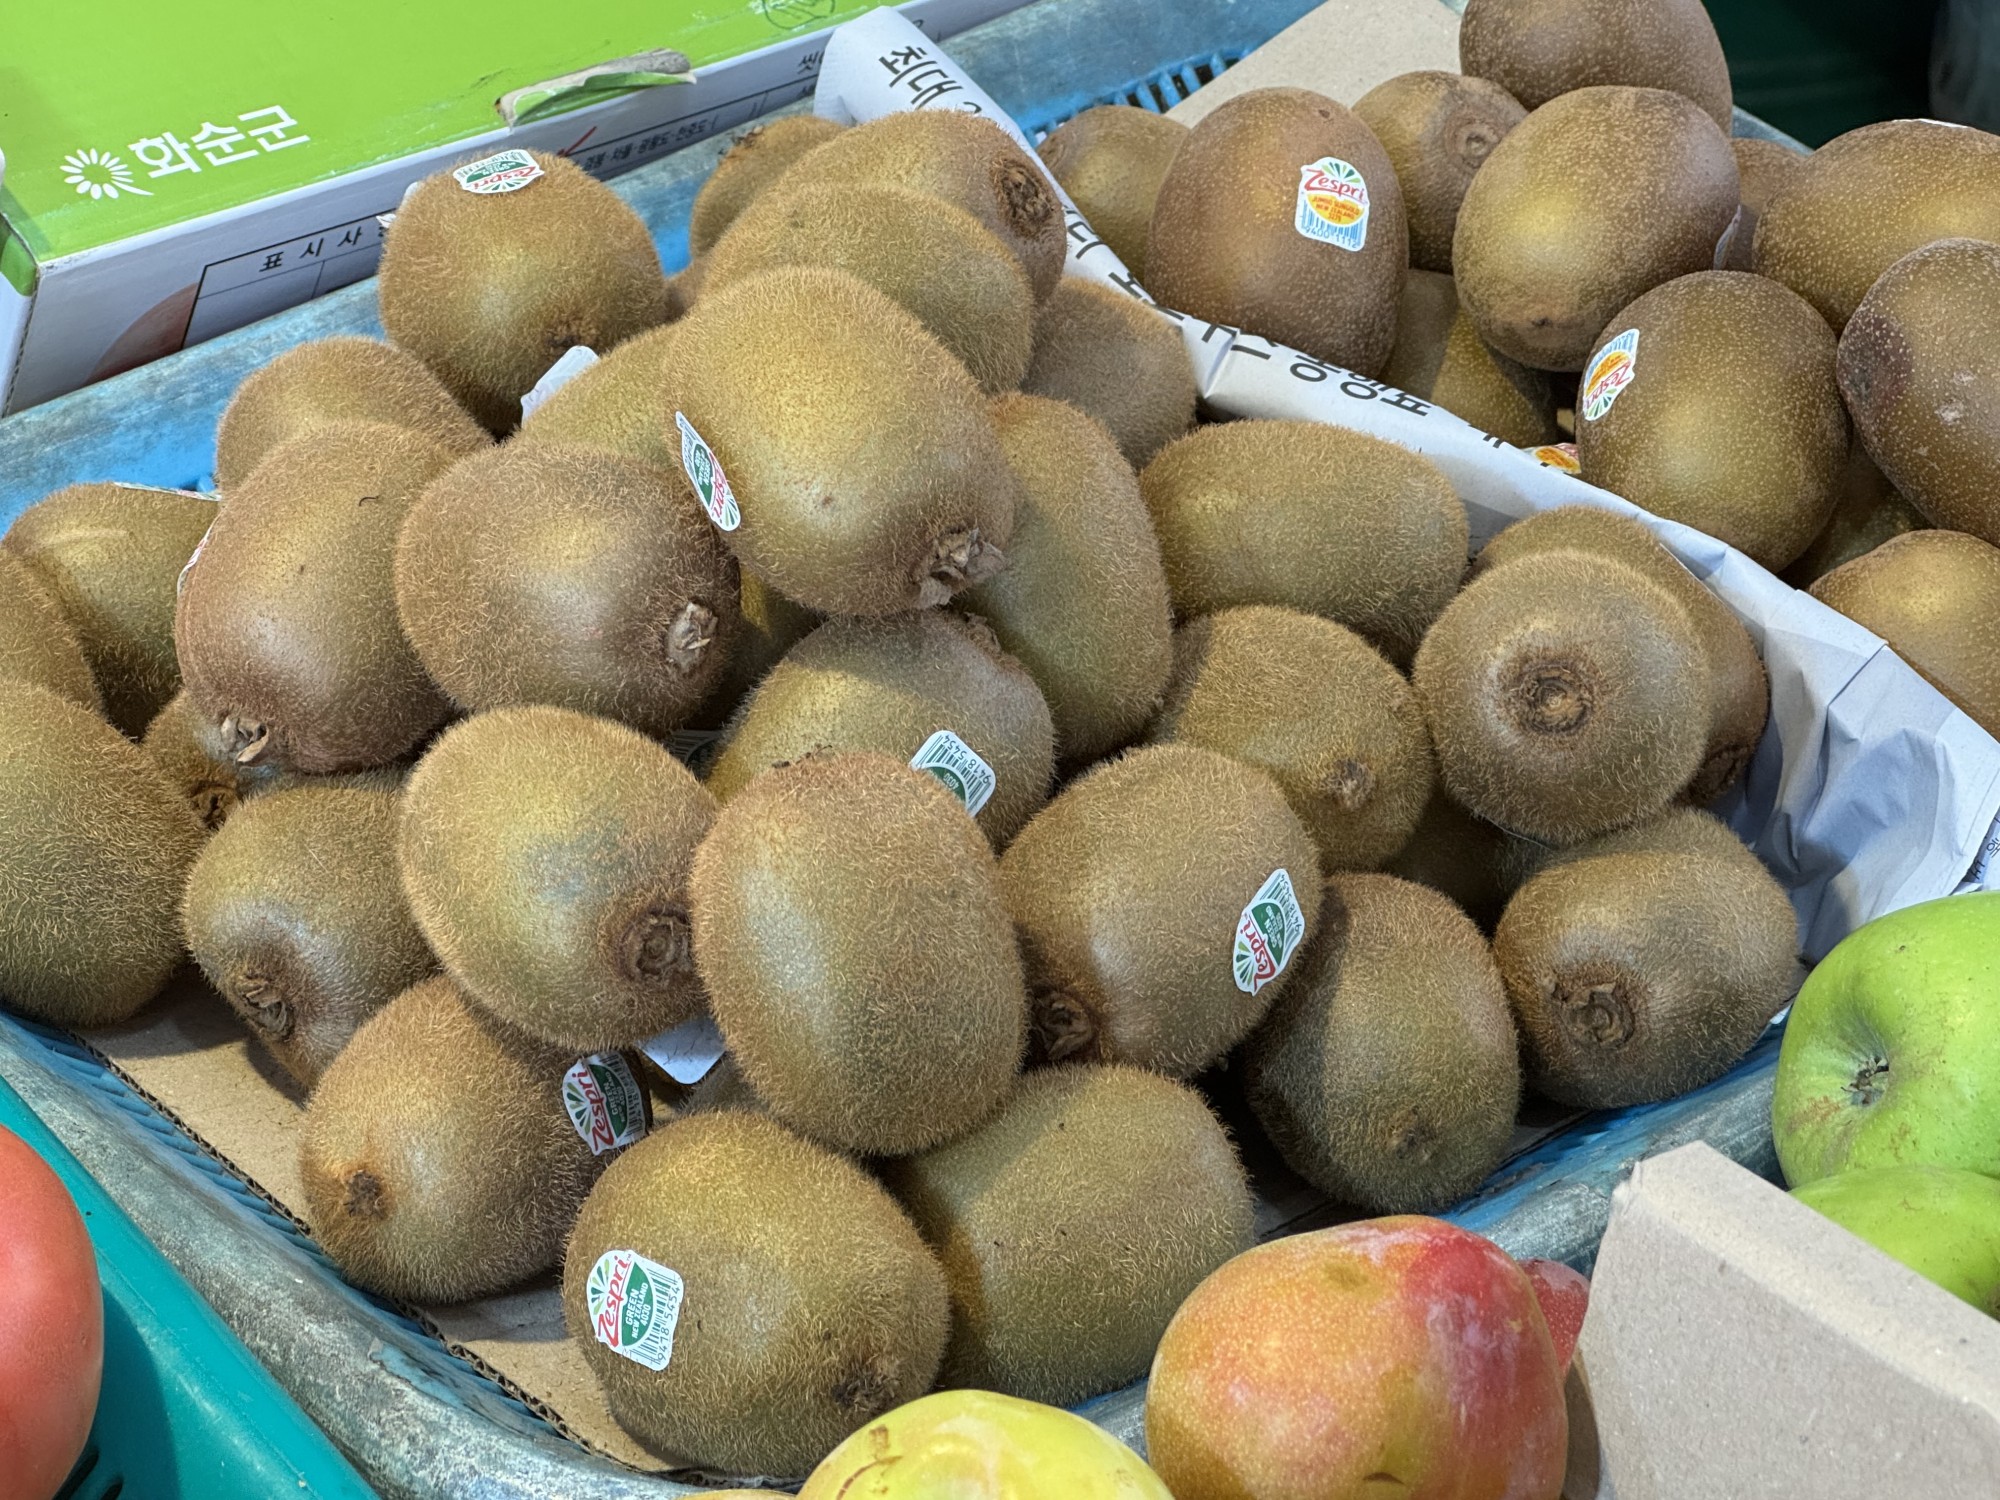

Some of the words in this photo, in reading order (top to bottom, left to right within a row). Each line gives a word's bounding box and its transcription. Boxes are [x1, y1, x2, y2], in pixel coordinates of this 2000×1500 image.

[879, 45, 964, 110] 최대
[127, 104, 311, 179] 화순군
[473, 166, 540, 190] Zespri
[1304, 168, 1365, 201] Zespri
[943, 735, 967, 760] 5454
[943, 773, 960, 790] 4030
[967, 758, 991, 784] 9418
[1288, 904, 1302, 932] 9418
[1240, 919, 1276, 992] Zespri
[572, 1068, 615, 1151] Zespri
[603, 1082, 619, 1115] GREEN
[597, 1255, 631, 1348] Zespri
[625, 1289, 640, 1325] GREEN
[634, 1282, 649, 1319] ZEALAND
[640, 1304, 651, 1326] 4030
[631, 1319, 640, 1339] NEW
[657, 1327, 670, 1361] 9418
[665, 1287, 680, 1321] 5454
